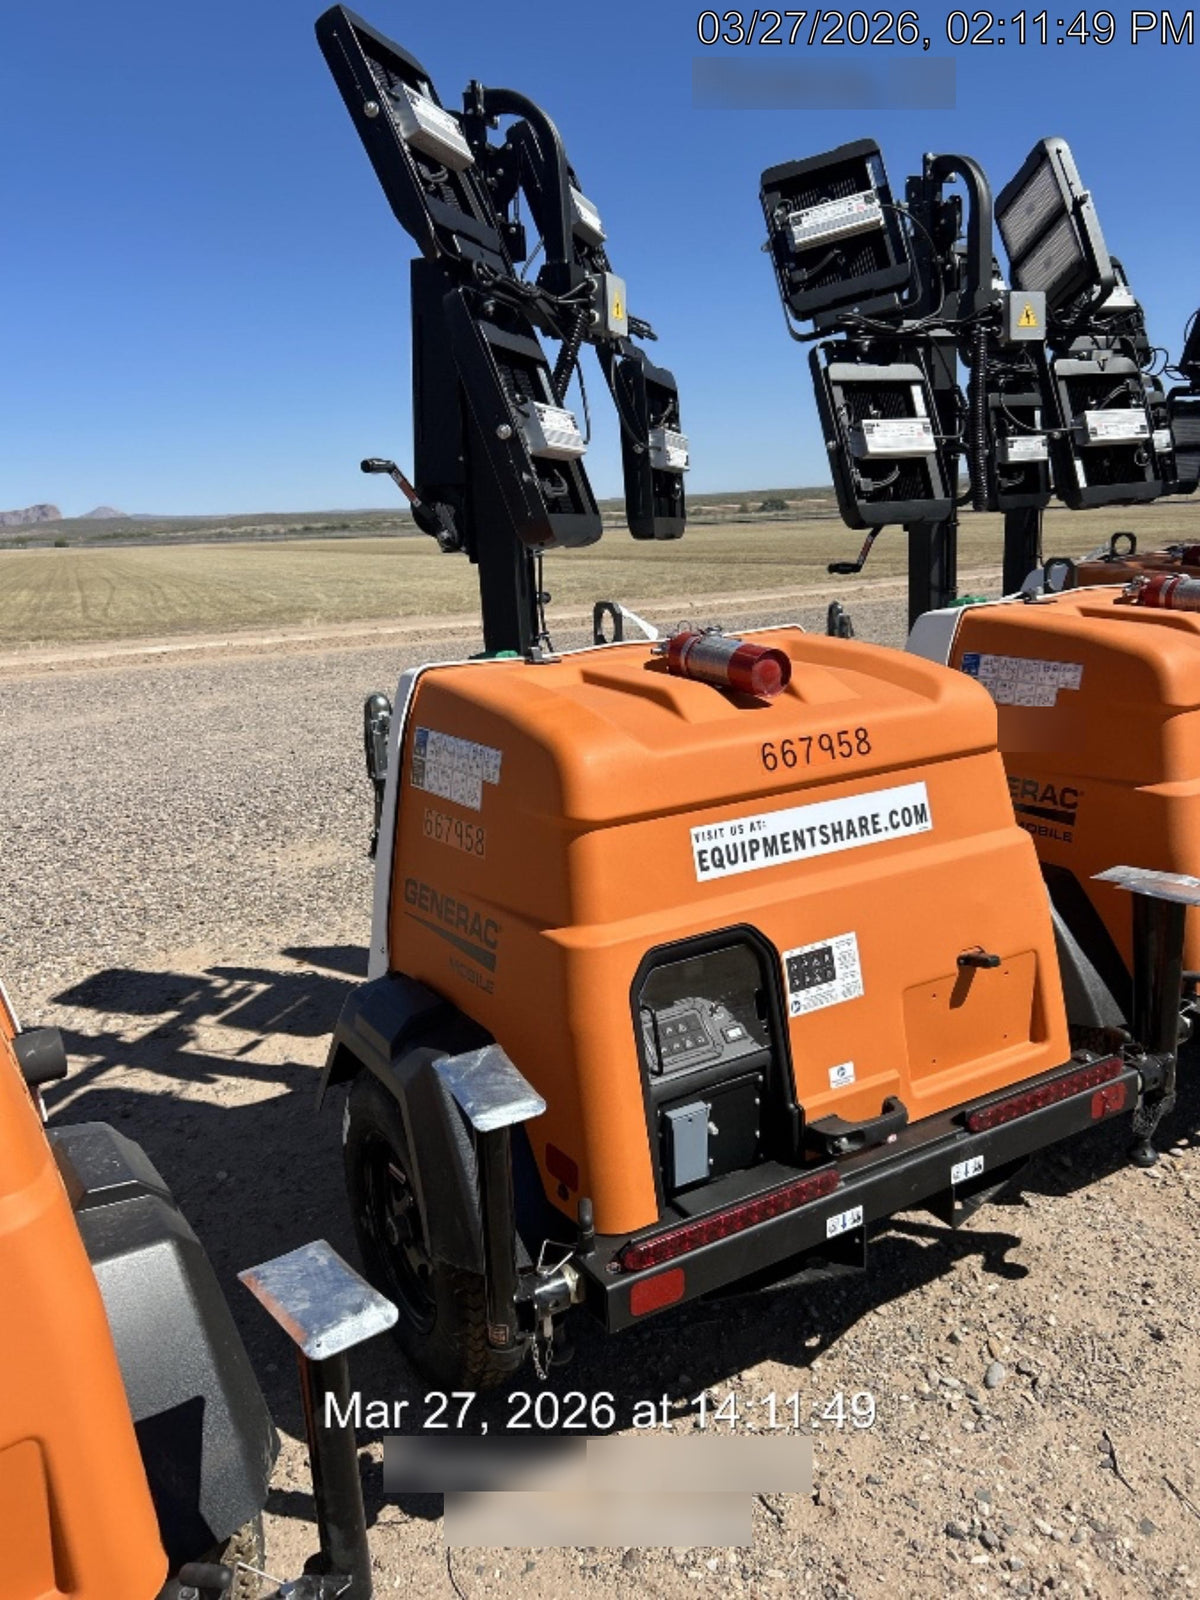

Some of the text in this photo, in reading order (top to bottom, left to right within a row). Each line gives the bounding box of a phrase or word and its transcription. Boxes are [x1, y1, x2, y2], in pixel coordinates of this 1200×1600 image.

[761, 727, 872, 771] 667958
[1006, 776, 1078, 810] ERAC
[424, 808, 485, 856] 667958
[694, 819, 767, 844] VISIT US AT:
[697, 803, 929, 872] EQUIPMENTSHARE.COM
[404, 878, 500, 950] GENERAC
[448, 955, 495, 995] MOBILE
